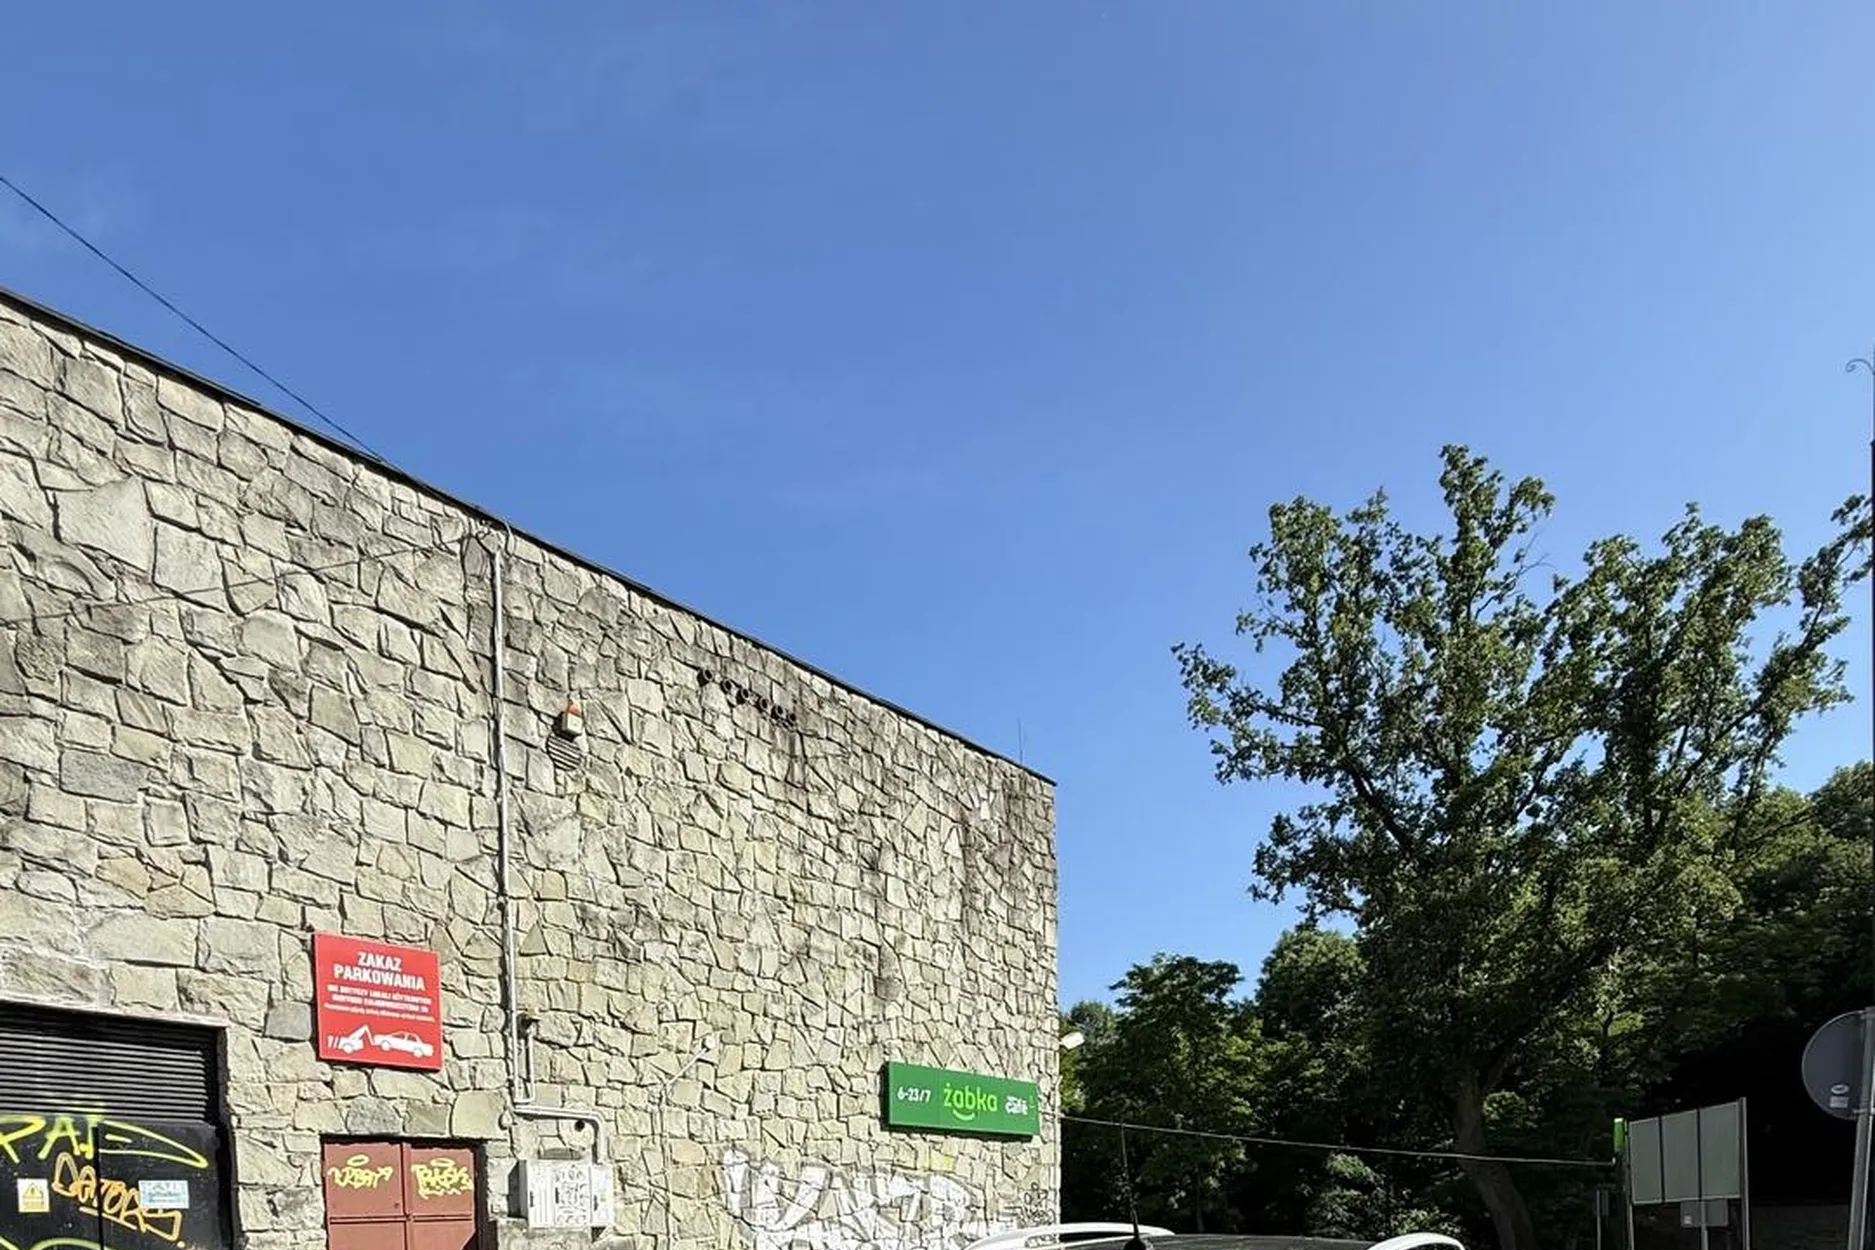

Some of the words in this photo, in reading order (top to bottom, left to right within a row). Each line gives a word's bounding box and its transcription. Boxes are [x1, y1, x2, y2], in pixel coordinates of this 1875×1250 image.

[357, 951, 402, 972] ZAKAZ
[333, 963, 425, 991] PARKOWANIA
[897, 1086, 931, 1103] 6-23/7
[943, 1083, 998, 1112] żabka
